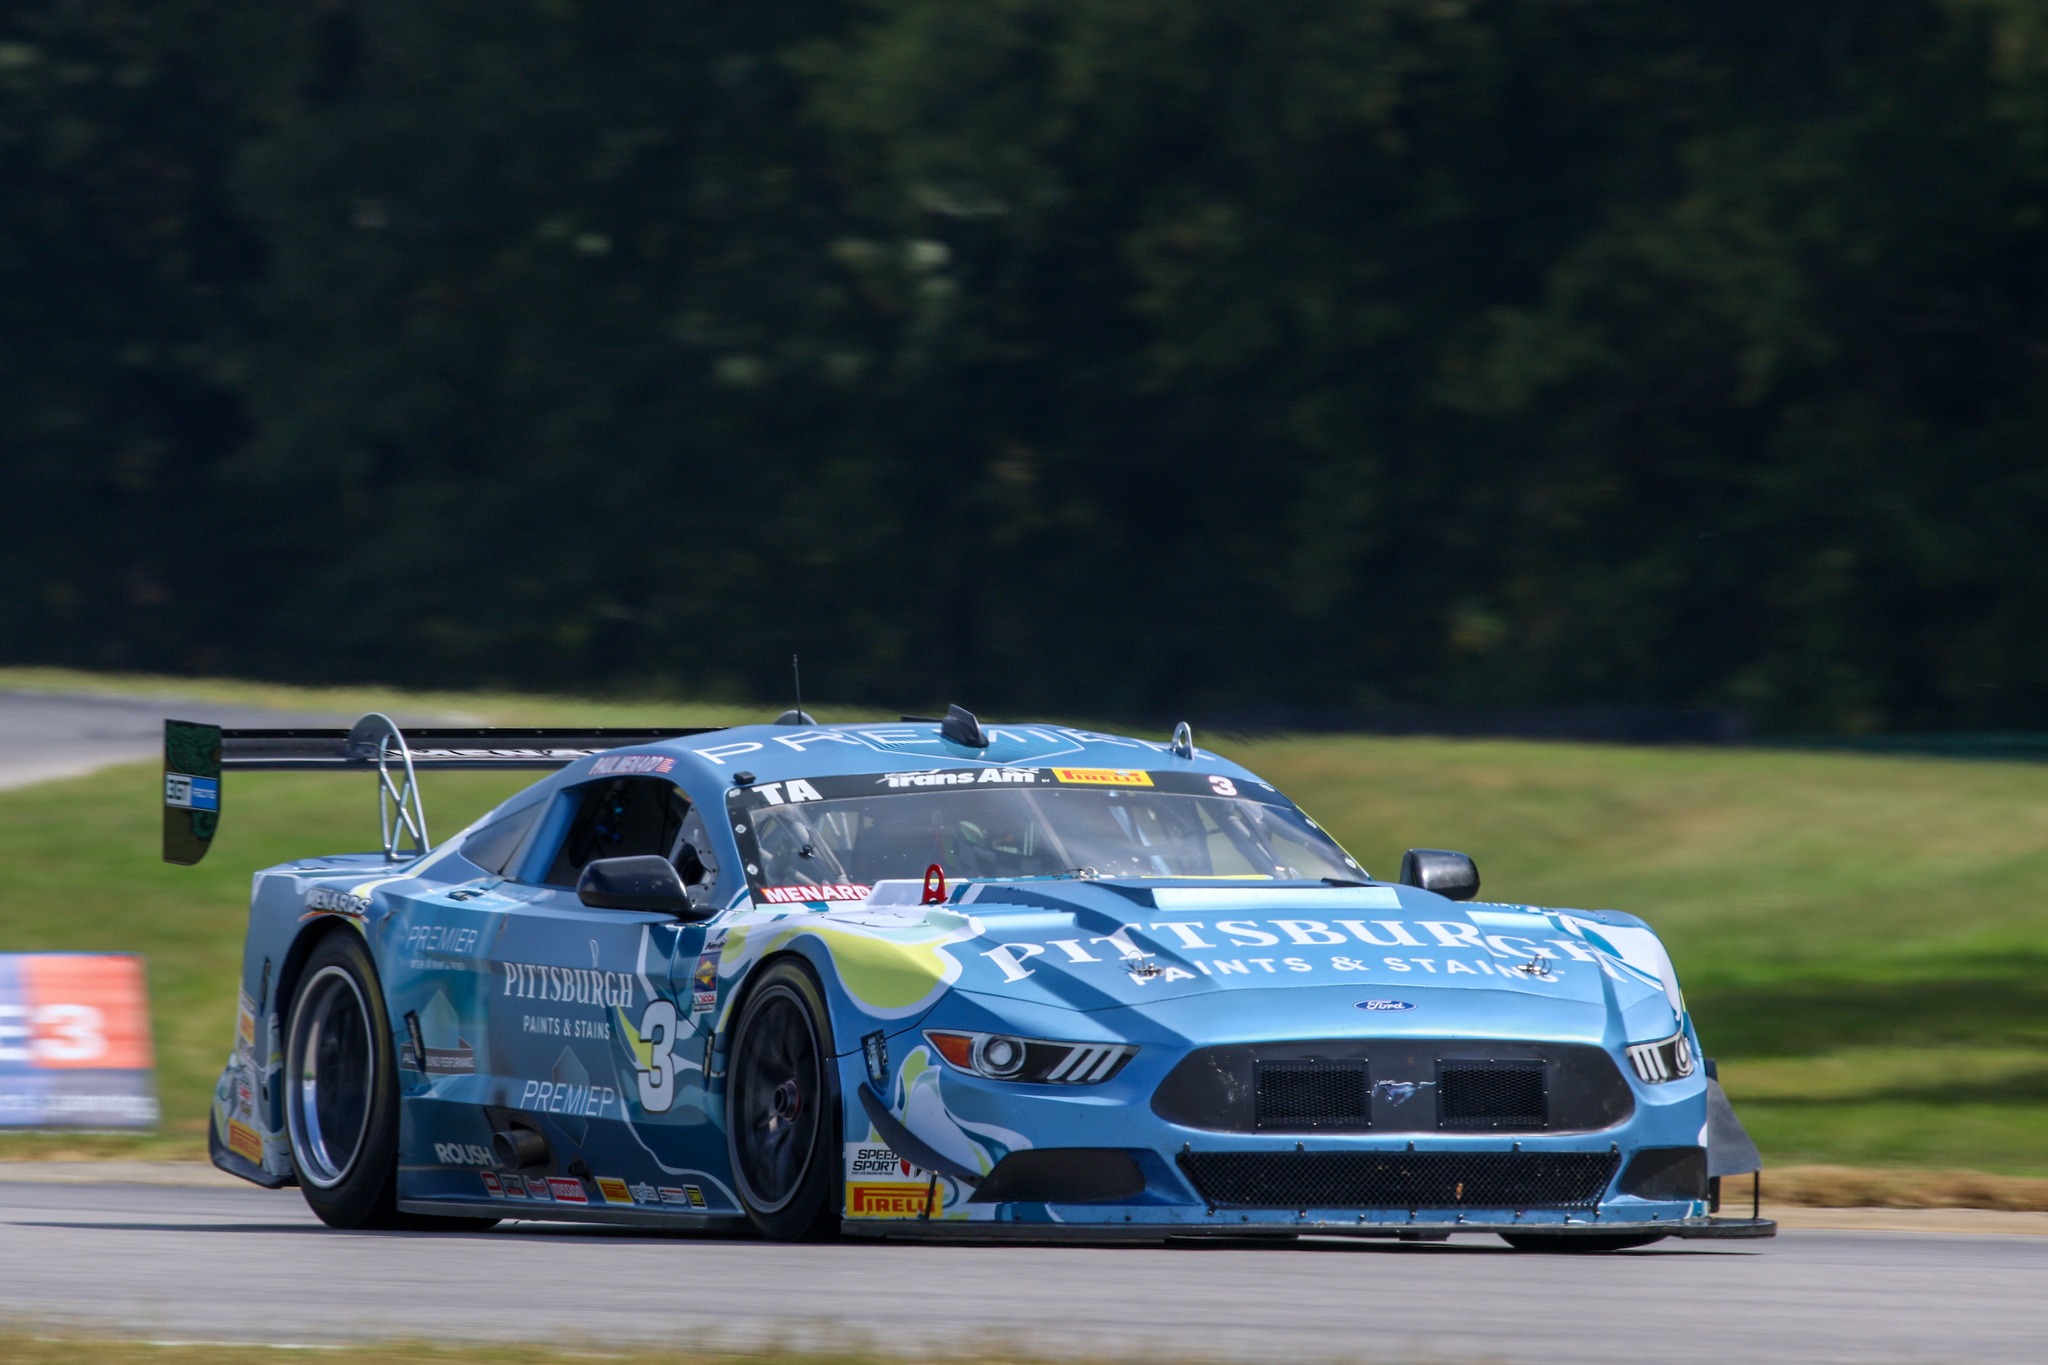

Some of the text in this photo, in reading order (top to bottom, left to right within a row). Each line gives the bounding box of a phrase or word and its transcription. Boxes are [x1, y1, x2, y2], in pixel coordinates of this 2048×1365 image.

[977, 767, 1036, 783] Am
[1062, 770, 1142, 782] PIRELLI
[1208, 775, 1238, 797] 3
[752, 779, 823, 805] TA
[404, 926, 478, 953] PREMIER
[980, 920, 1628, 984] PITTSBURGH
[1331, 957, 1371, 971] &
[503, 962, 634, 1009] PITTSBURGH
[523, 1015, 610, 1041] PAINTS & STAINS
[637, 999, 677, 1113] 3
[434, 1143, 494, 1166] ROUSH
[852, 1160, 899, 1171] SPORT
